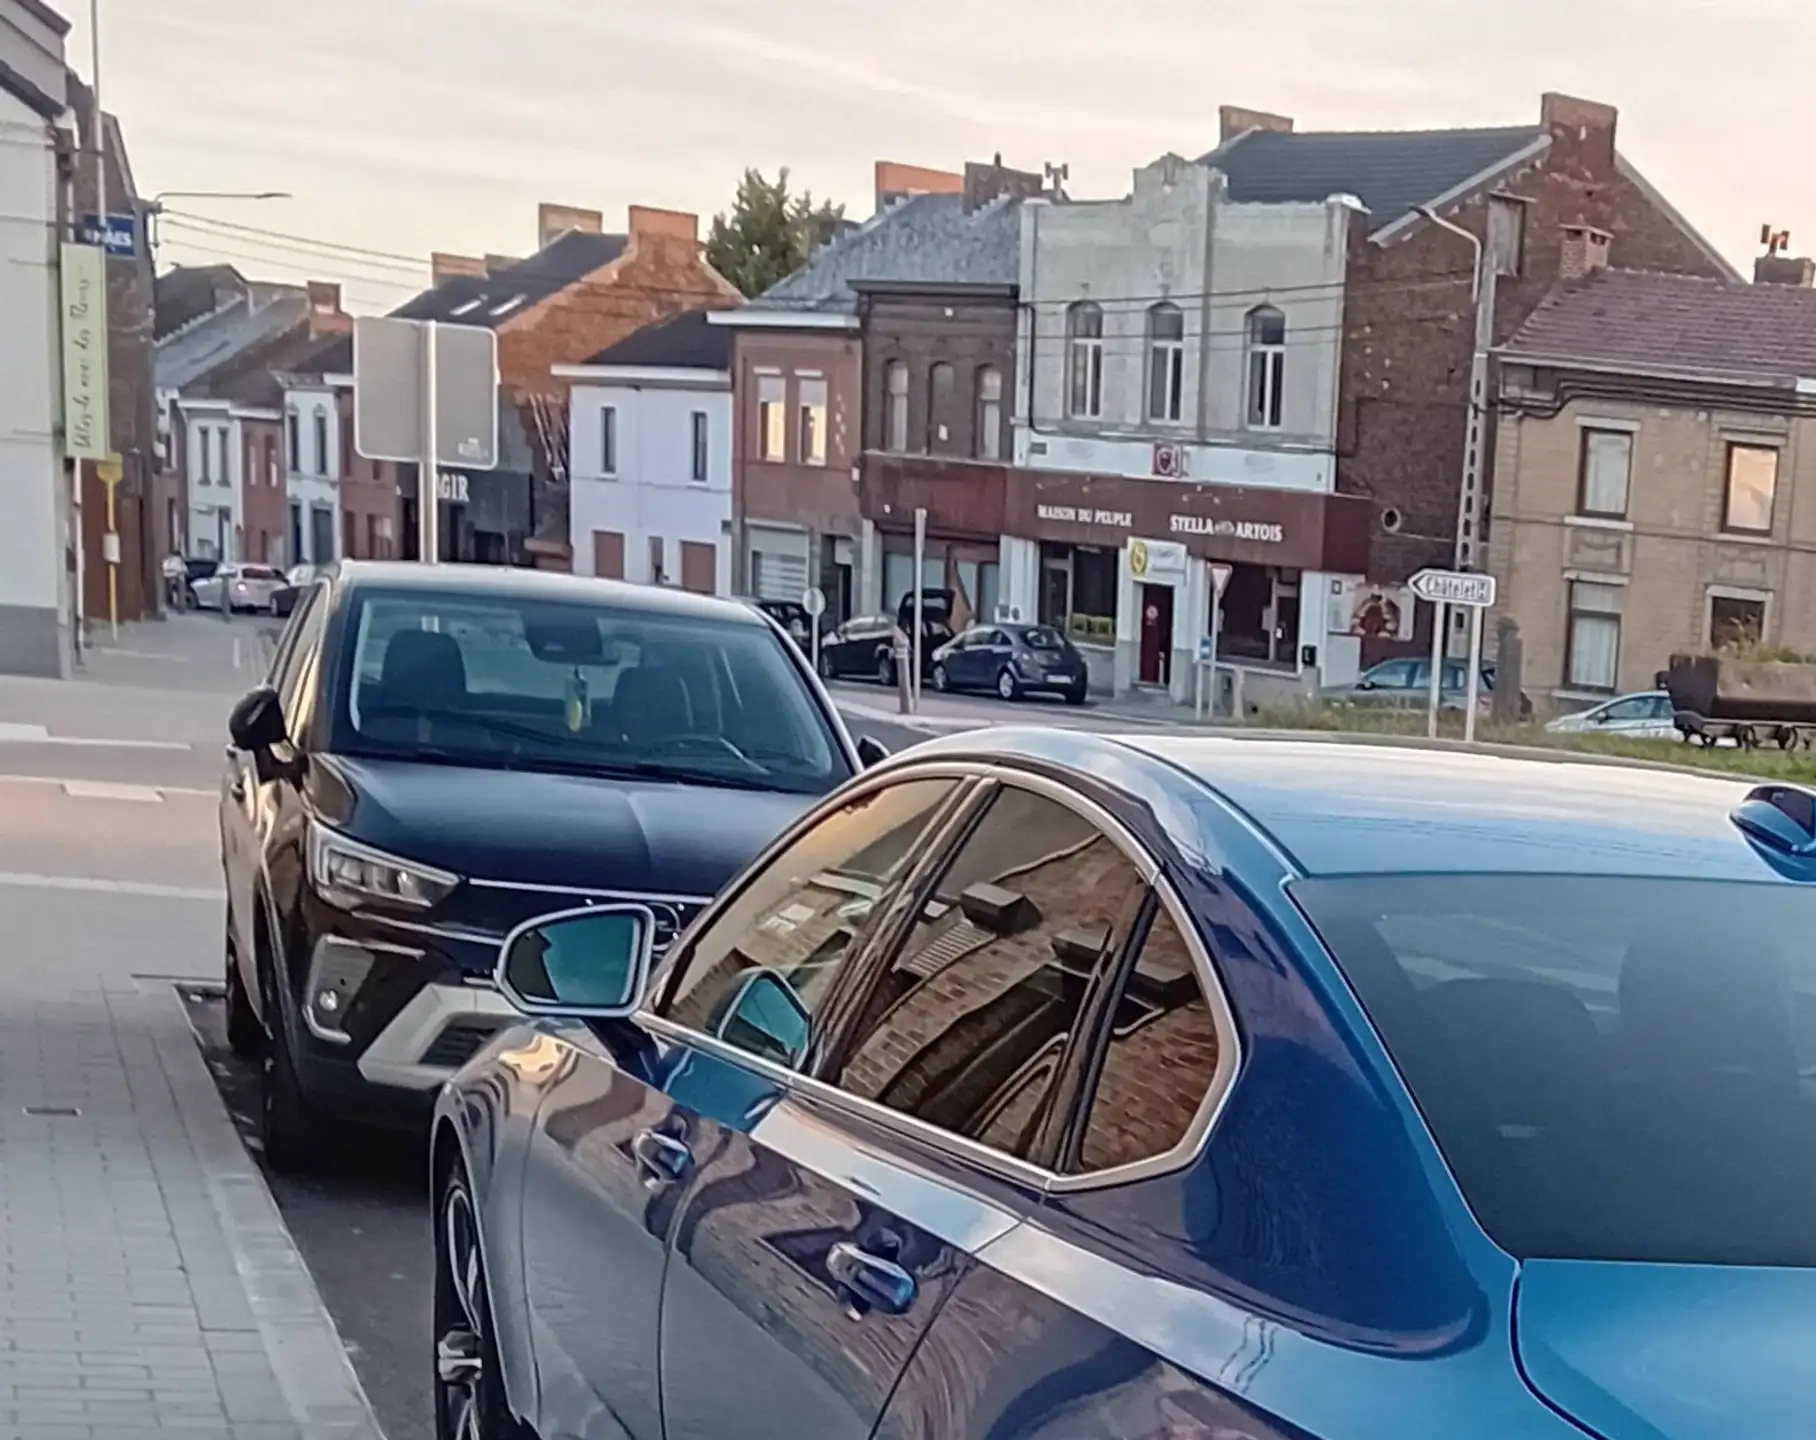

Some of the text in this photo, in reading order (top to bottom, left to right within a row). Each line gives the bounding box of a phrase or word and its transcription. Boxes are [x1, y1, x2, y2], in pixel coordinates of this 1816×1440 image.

[1078, 507, 1093, 523] DU
[1095, 508, 1133, 528] PEUPLE
[1169, 513, 1283, 543] STELLA ARTOIS
